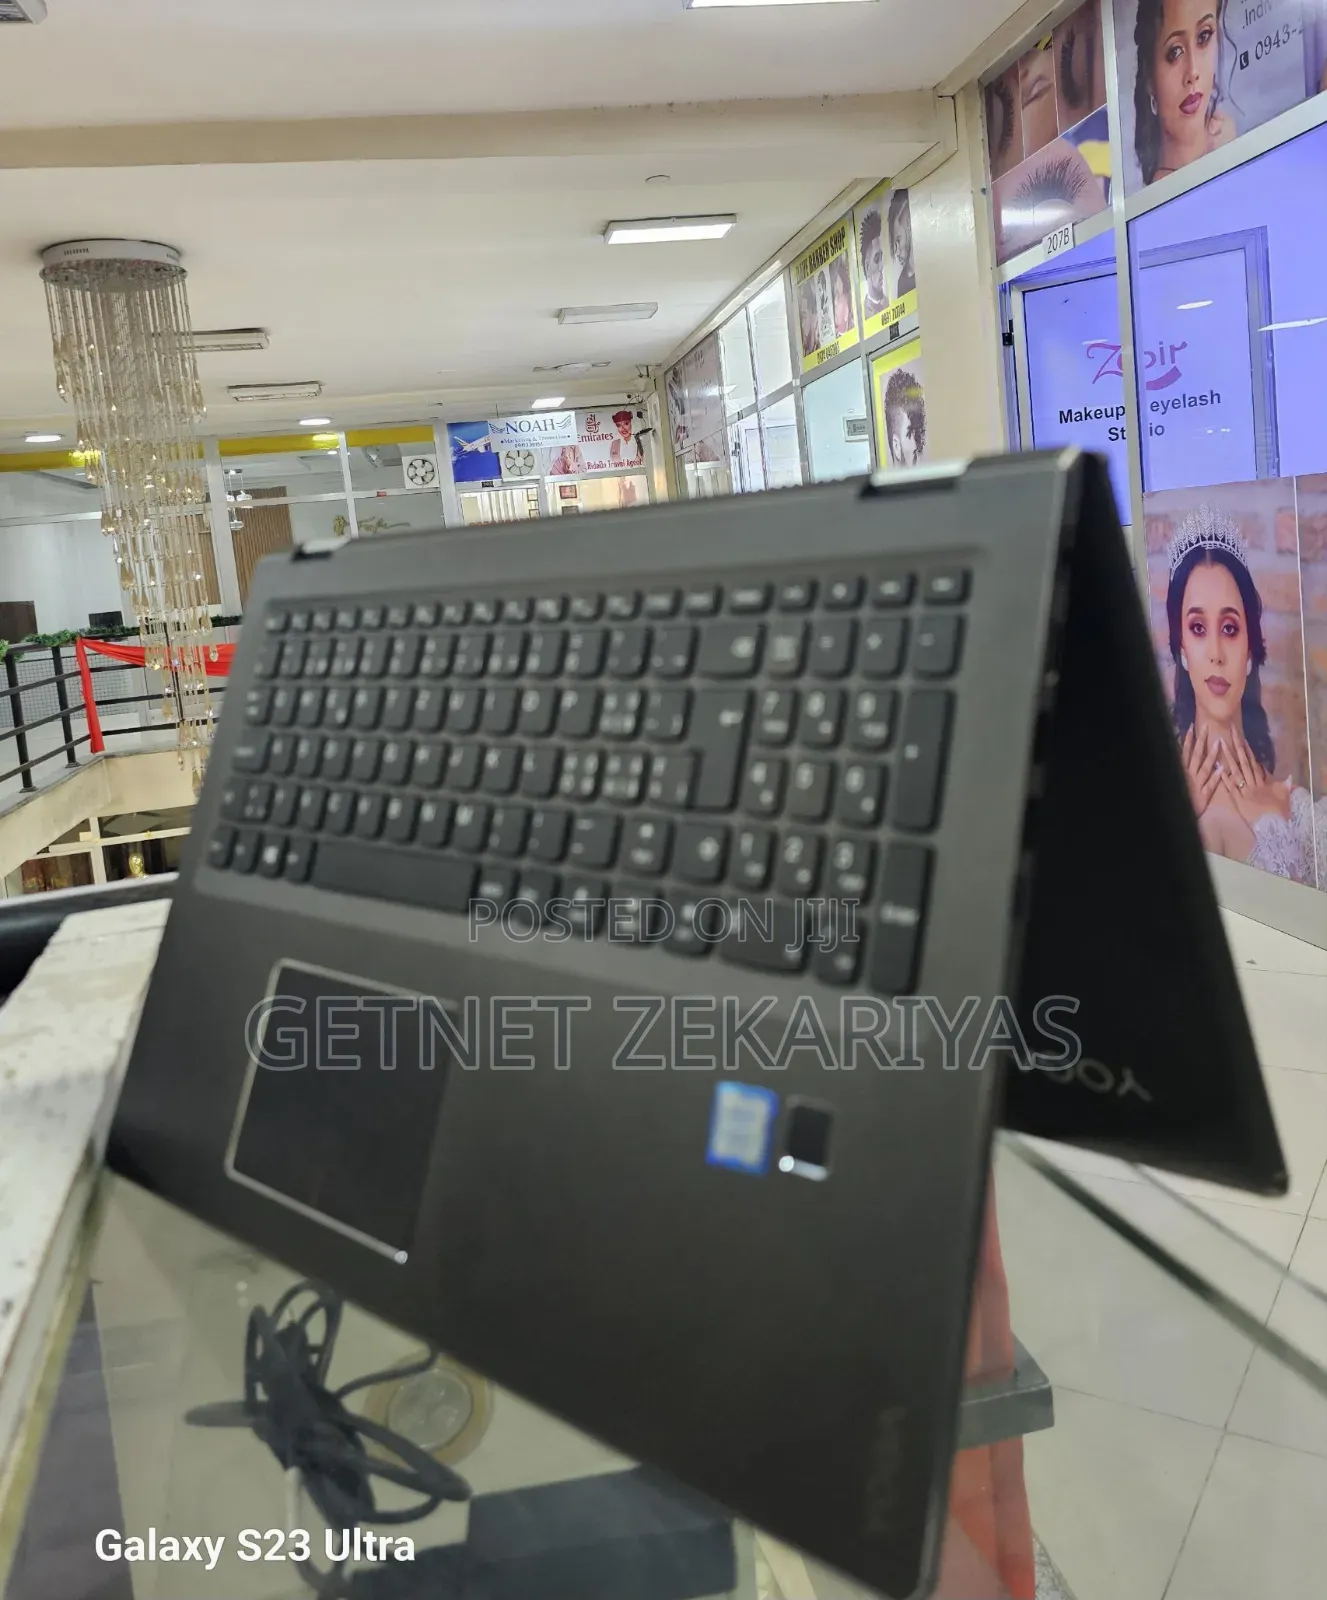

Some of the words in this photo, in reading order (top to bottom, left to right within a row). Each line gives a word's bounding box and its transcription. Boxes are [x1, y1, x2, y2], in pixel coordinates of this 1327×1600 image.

[1255, 23, 1304, 60] 0943-
[829, 225, 846, 256] SHOP
[1047, 226, 1070, 255] 207B
[1059, 403, 1126, 424] Makeup
[1150, 390, 1221, 415] eyelash
[506, 418, 555, 435] NOAH
[1108, 422, 1165, 441] Stio
